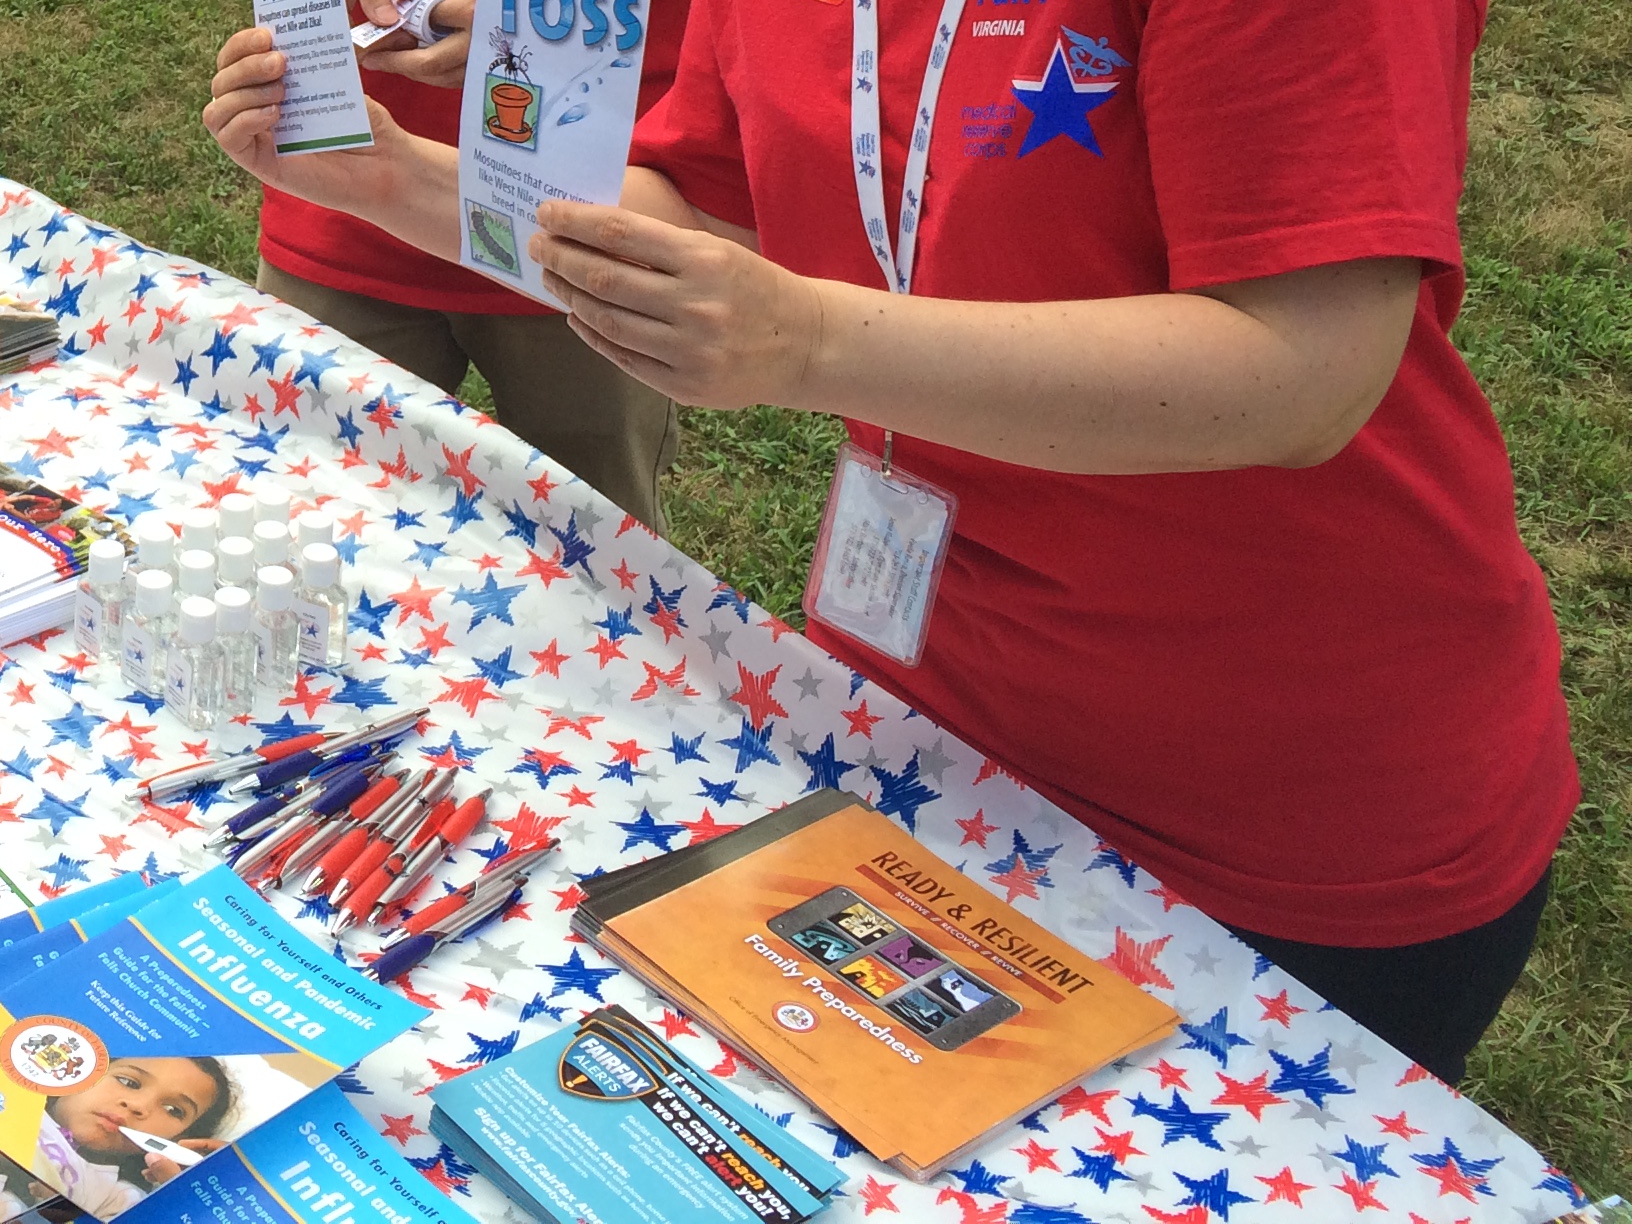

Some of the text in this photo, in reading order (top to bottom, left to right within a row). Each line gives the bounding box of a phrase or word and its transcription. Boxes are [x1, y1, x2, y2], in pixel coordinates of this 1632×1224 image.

[972, 20, 1025, 38] VIRGINIA
[473, 148, 569, 200] Mosquitoes that carry
[478, 167, 494, 186] like
[494, 176, 516, 196] West
[517, 186, 535, 206] Nile
[491, 191, 515, 213] breed
[516, 205, 525, 218] in
[27, 529, 64, 555] Hero.
[223, 894, 383, 1011] Caring for Yourself and Others
[870, 850, 1094, 995] READY & RESILIENT
[894, 891, 1023, 978] SURVIVE RECOVER REVIVE
[96, 952, 200, 1039] Falls Church Community
[111, 946, 202, 1023] Guide for the Fairfax
[138, 953, 207, 1010] A Preparedness
[177, 931, 327, 1039] Influenza
[191, 896, 378, 1031] Seasonal and Pandemic
[743, 933, 924, 1063] Family Preparedness
[84, 989, 148, 1042] Future Reference
[89, 979, 163, 1040] Keep this Guide for
[572, 1052, 622, 1093] ALERTS
[579, 1036, 650, 1093] FAIRFAX
[666, 1071, 702, 1102] If we
[503, 1066, 602, 1151] Customize Your Fairfax
[618, 1122, 657, 1155] sends you
[297, 1120, 377, 1197] Seasonal
[331, 1121, 370, 1160] Caring
[368, 1158, 390, 1177] for
[388, 1177, 439, 1219] Yourself
[472, 1106, 579, 1201] Sign up for Fairfax
[624, 1114, 721, 1196] Fairfax FREE alert
[651, 1102, 775, 1216] we can't alert you!
[656, 1086, 794, 1218] If we can't reach you,
[190, 1180, 213, 1205] Falls
[206, 1175, 235, 1205] Guide
[232, 1205, 251, 1221] for
